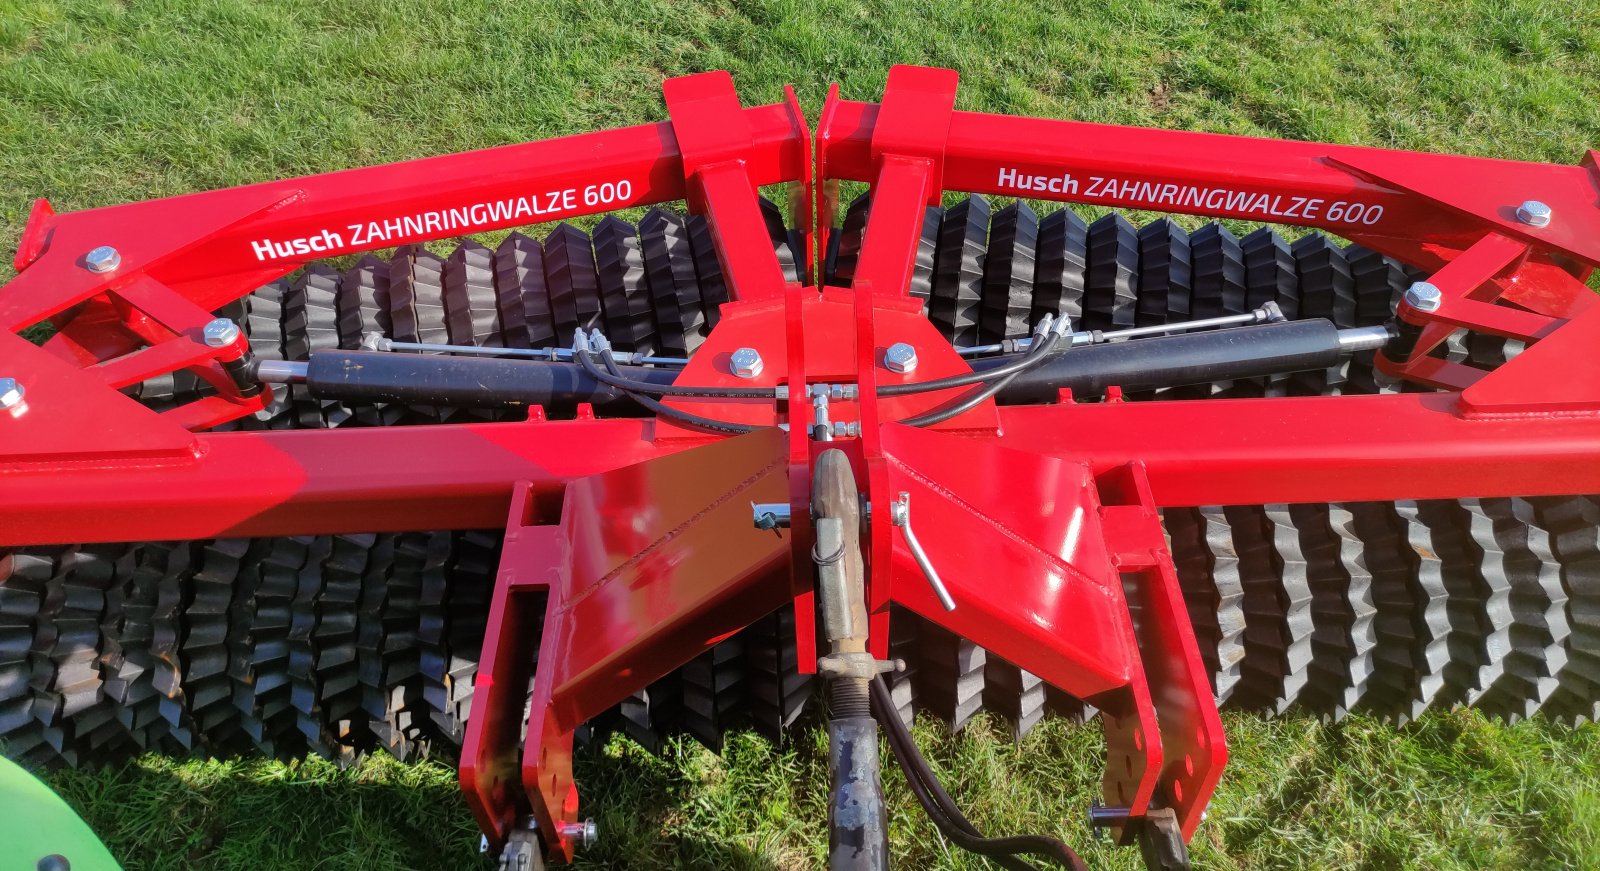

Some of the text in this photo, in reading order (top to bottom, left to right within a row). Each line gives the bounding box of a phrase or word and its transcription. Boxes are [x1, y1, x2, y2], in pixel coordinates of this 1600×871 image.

[250, 179, 633, 261] Husch ZAHNRINGWALZE 600
[998, 167, 1385, 226] Husch ZAHNRINGWALZE 600
